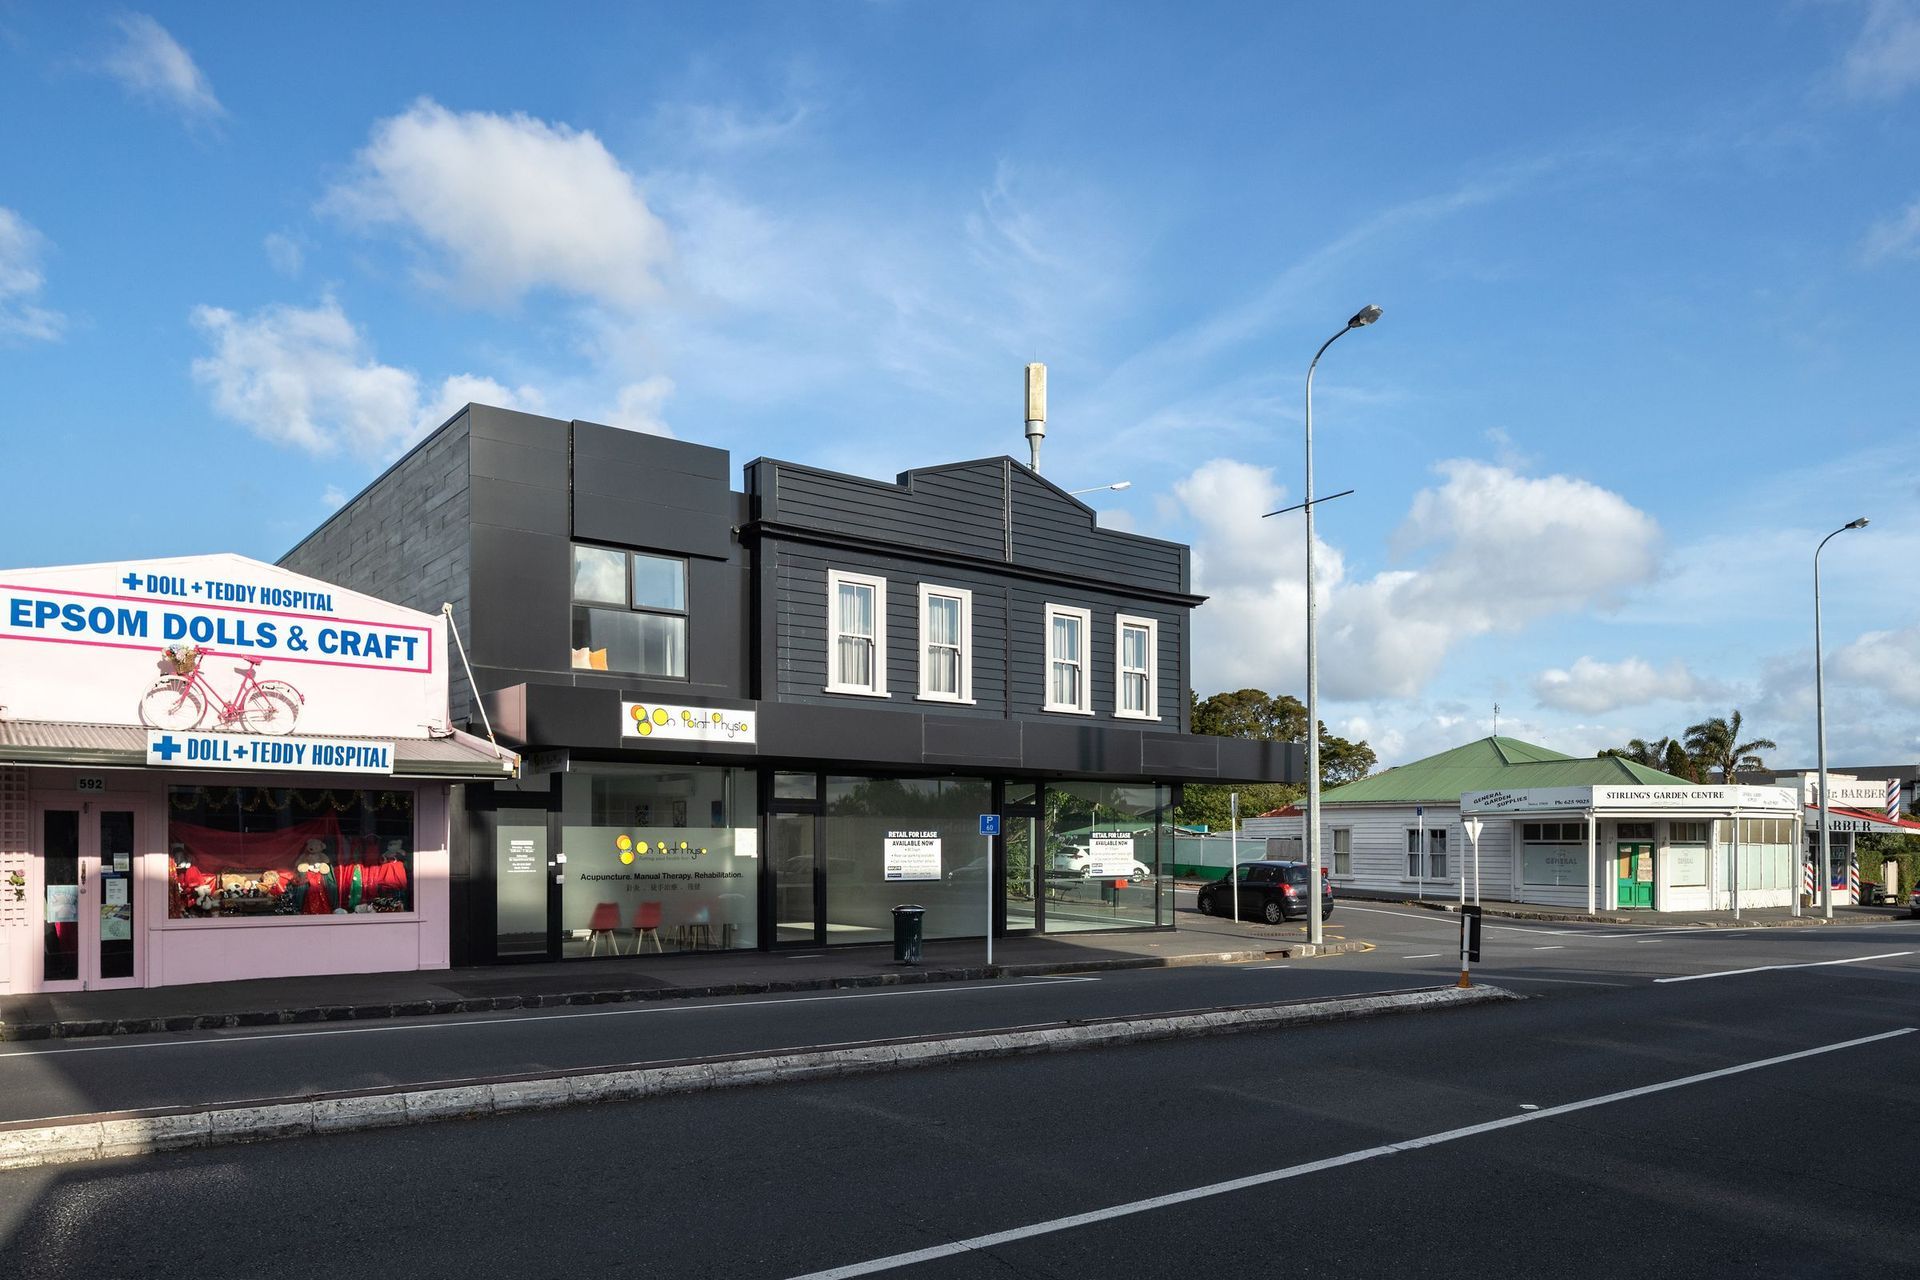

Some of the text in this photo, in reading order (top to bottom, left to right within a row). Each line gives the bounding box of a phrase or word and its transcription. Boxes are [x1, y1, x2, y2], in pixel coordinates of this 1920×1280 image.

[146, 574, 188, 597] DOLL
[205, 580, 257, 604] TEDDY
[260, 587, 334, 612] HOSPITAL
[10, 598, 418, 661] EPSOM DOLLS & CRAFT
[712, 712, 748, 738] Physio
[312, 744, 389, 768] HOSPITAL
[79, 779, 103, 789] 592
[1473, 791, 1503, 804] GENERAL
[1606, 791, 1724, 800] STIRLING'S GARDEN CENTRE
[1841, 788, 1885, 799] BARBER
[1484, 794, 1511, 806] GARDEN
[1496, 796, 1527, 808] SUPPLIES
[986, 816, 994, 824] P
[1545, 857, 1578, 865] GENERAL
[580, 872, 744, 882] Acupuncture. Manual Therapy. Rehabilitation.
